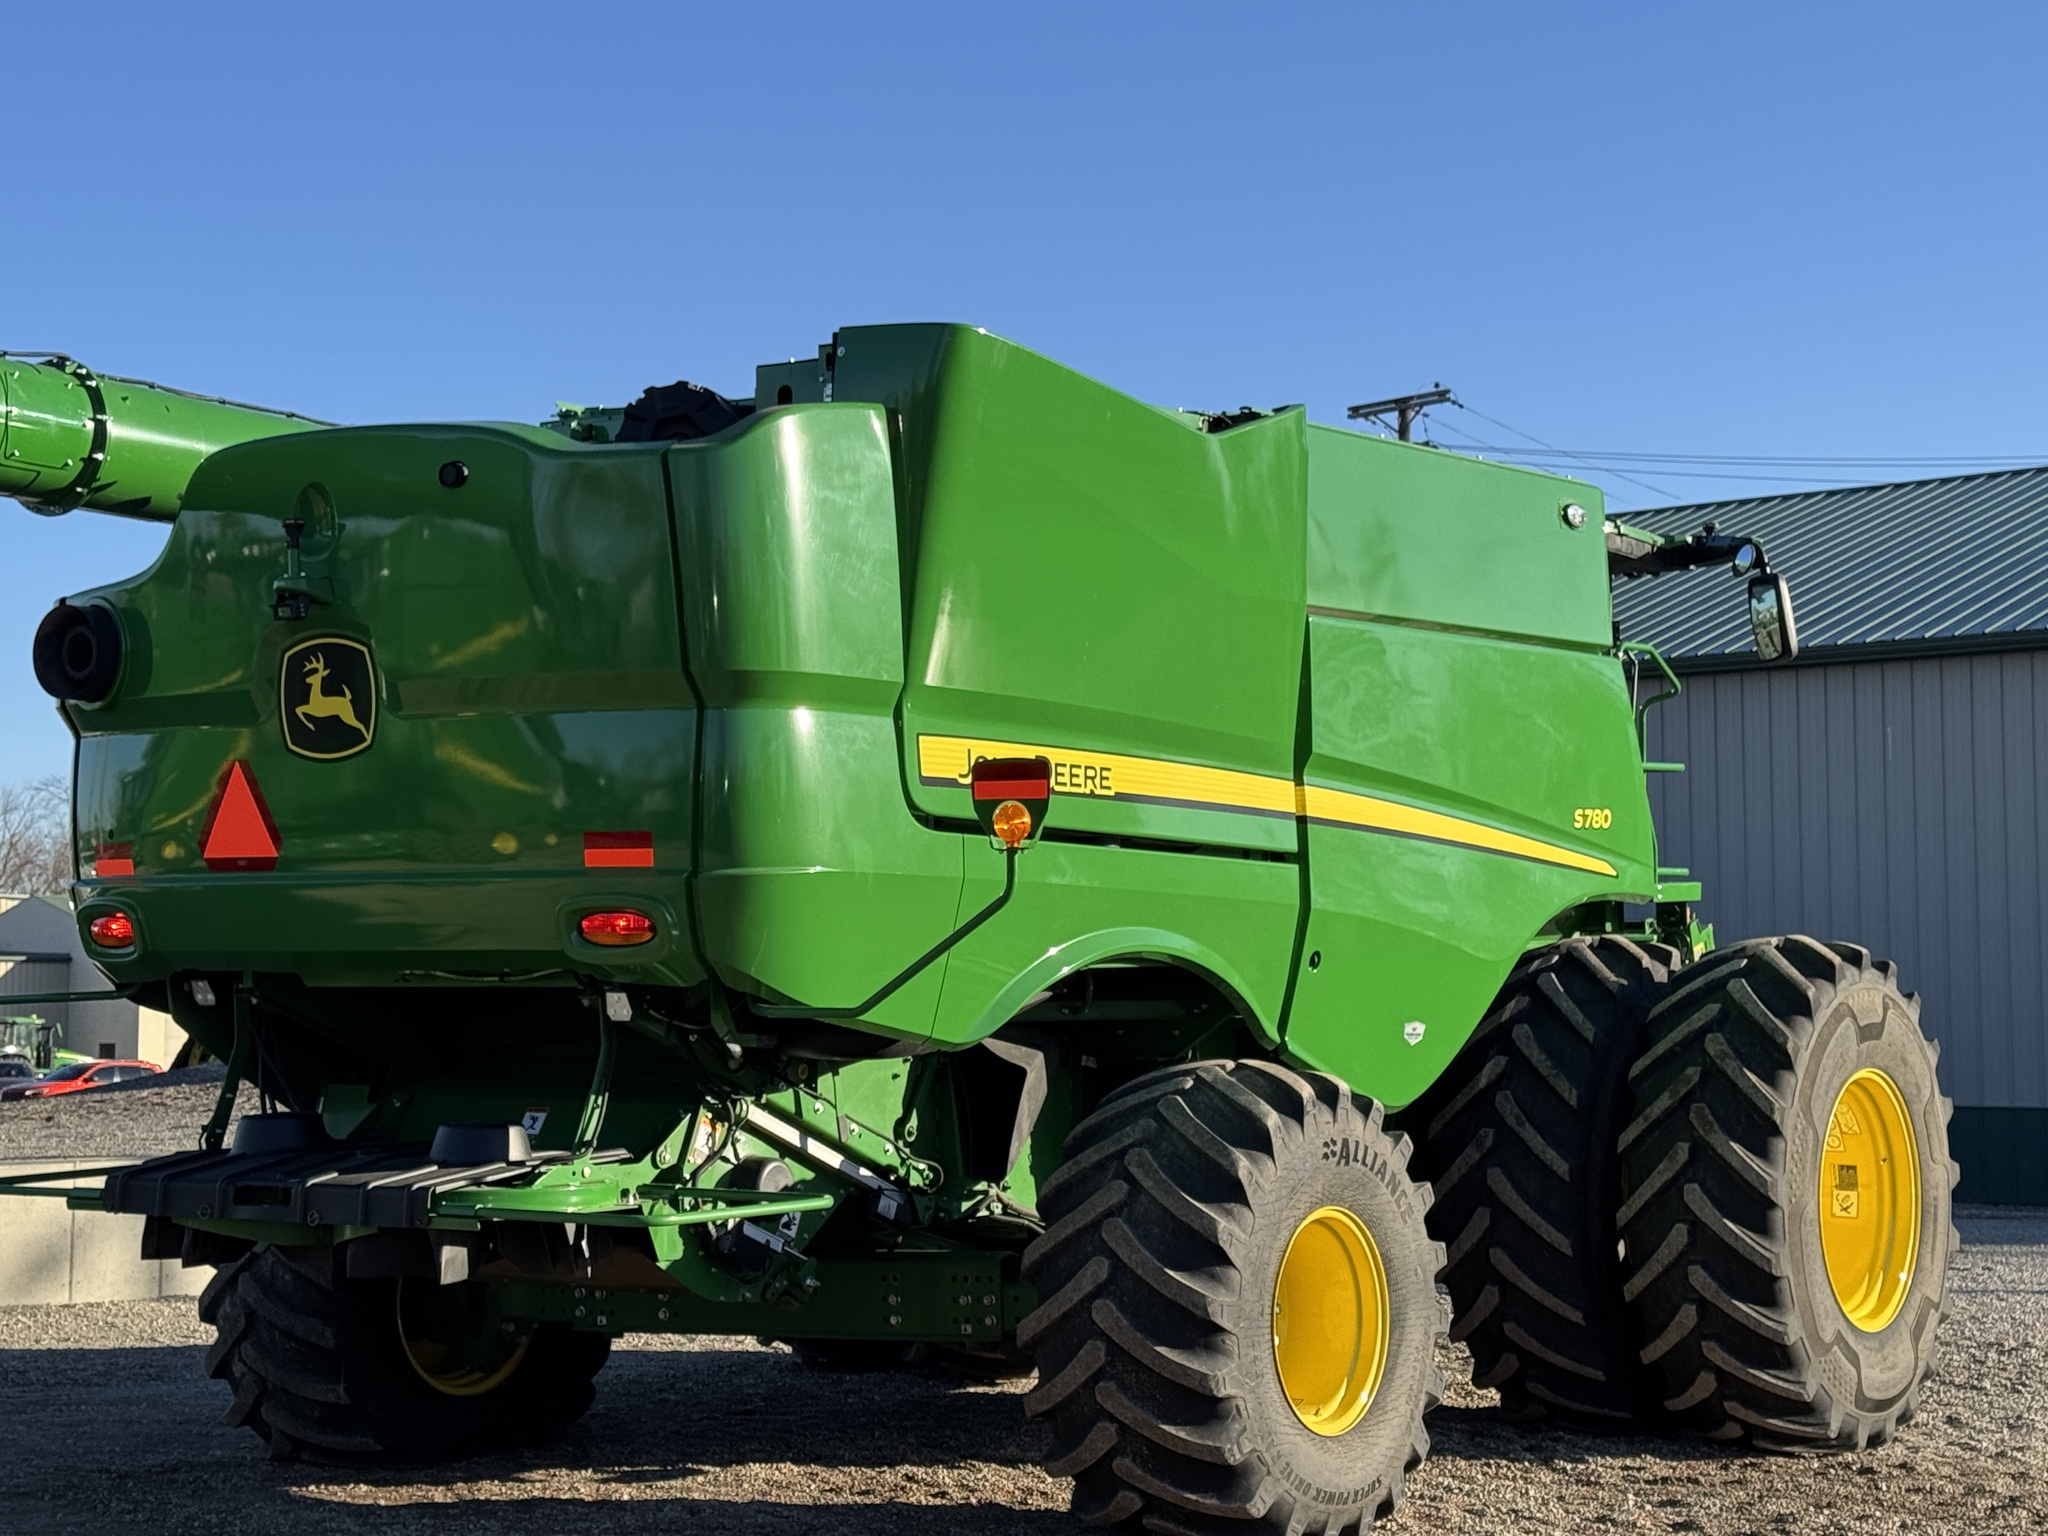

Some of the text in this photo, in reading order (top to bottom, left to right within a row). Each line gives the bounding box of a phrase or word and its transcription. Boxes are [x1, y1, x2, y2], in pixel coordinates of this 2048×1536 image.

[1573, 808, 1612, 829] S780
[1336, 1138, 1414, 1226] ALLIANCE
[1279, 1461, 1382, 1506] SUPER POWER DRIVE
